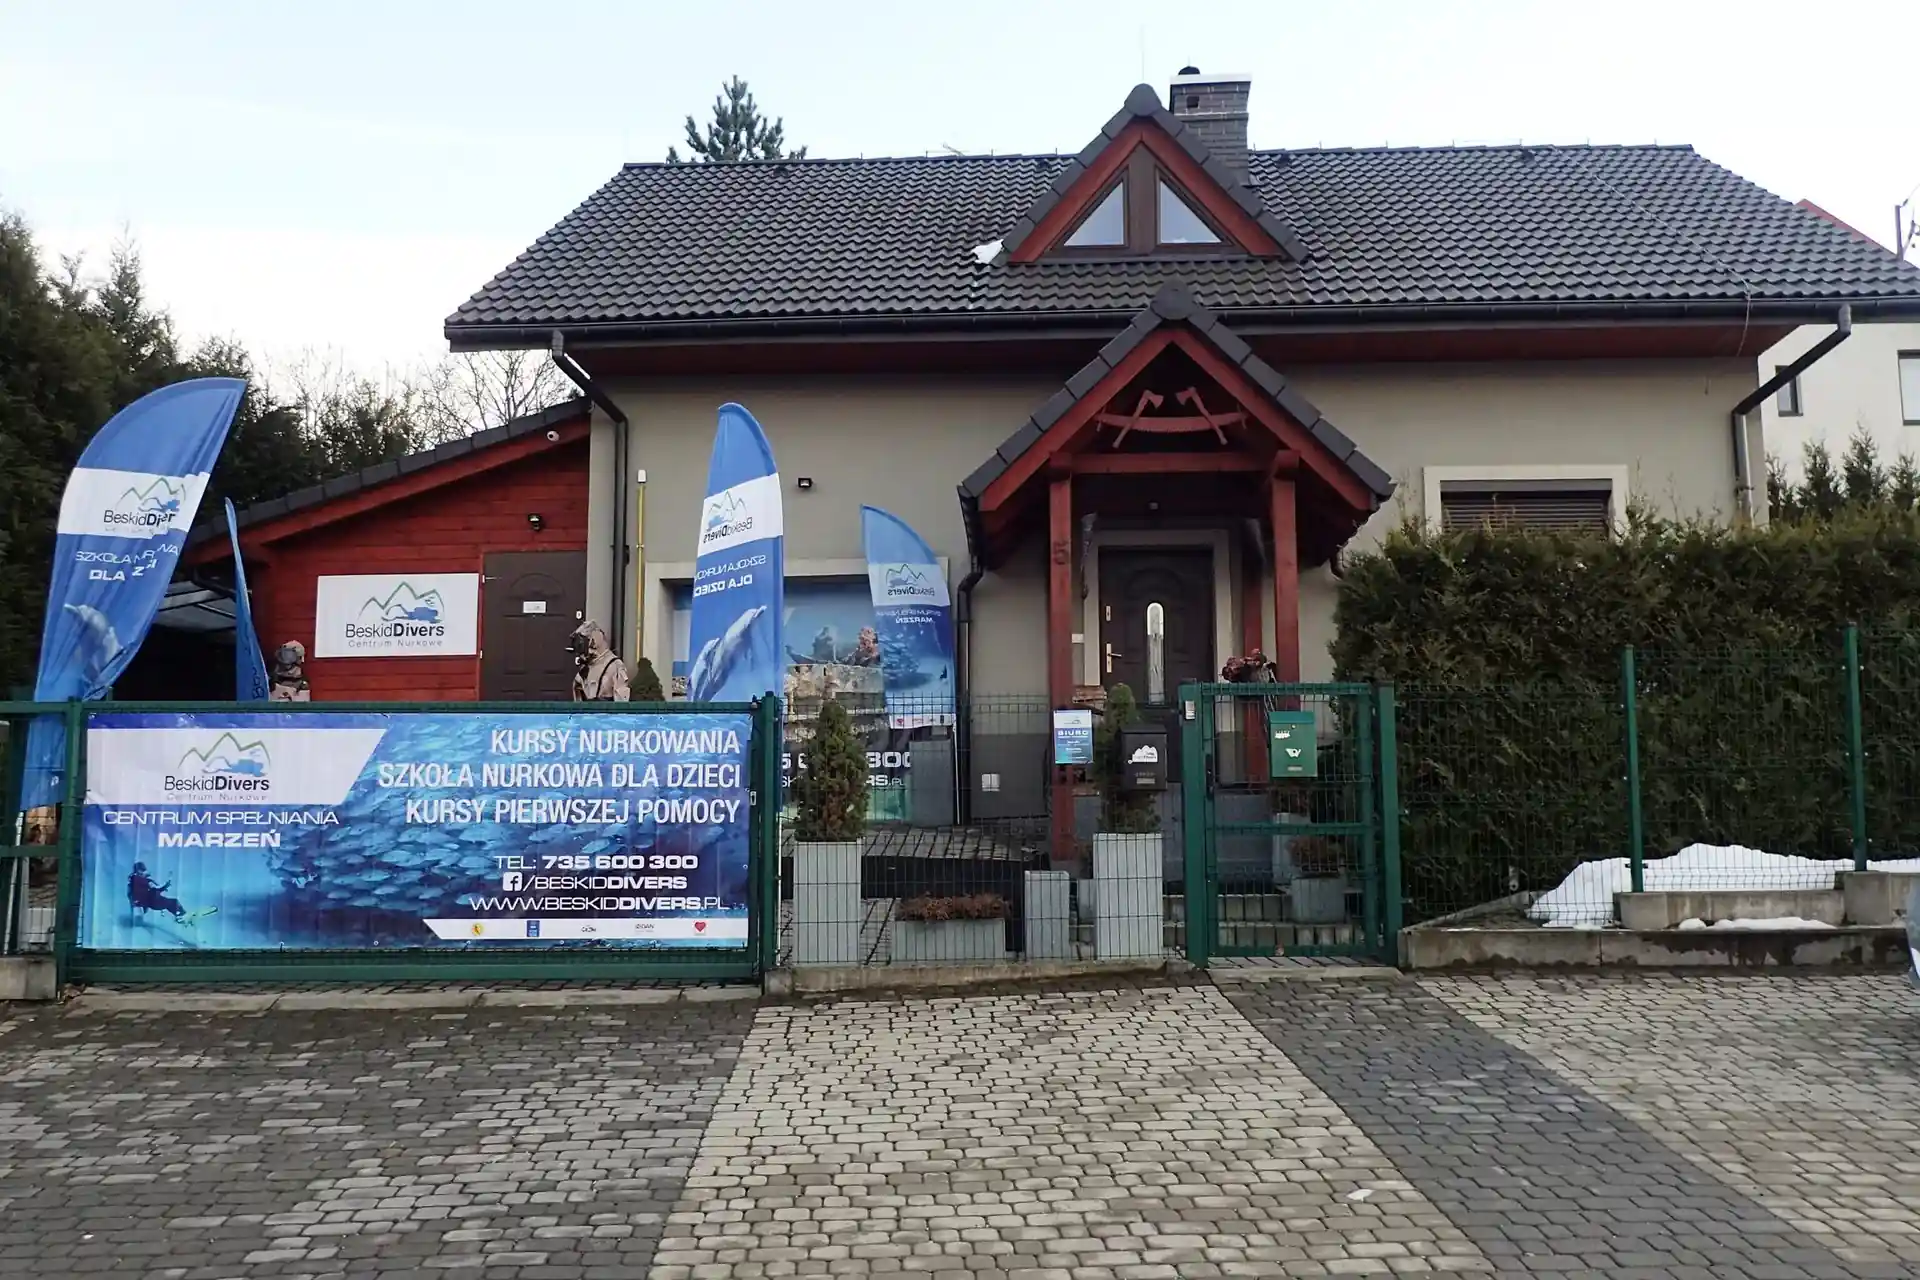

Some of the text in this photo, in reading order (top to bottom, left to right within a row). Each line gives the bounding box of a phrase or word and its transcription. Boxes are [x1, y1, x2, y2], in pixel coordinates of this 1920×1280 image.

[88, 569, 126, 581] DLA
[345, 622, 445, 638] BeskidDivers
[348, 638, 443, 648] Centrum Nurkowe
[491, 728, 741, 754] KURSY NURKOWANIA
[378, 761, 741, 788] SZKOŁA NURKOWA DLA DZIECI
[164, 775, 270, 791] BeskidDivers
[103, 810, 340, 825] CENTRUM SPEŁNIANIA
[405, 798, 741, 825] KURSY PIERWSZEJ POMOCY
[158, 829, 281, 848] MARZEŃ
[494, 855, 699, 870] TEL: 735 600 300
[469, 896, 730, 911] WWW.BESKIDDIVERS.PL
